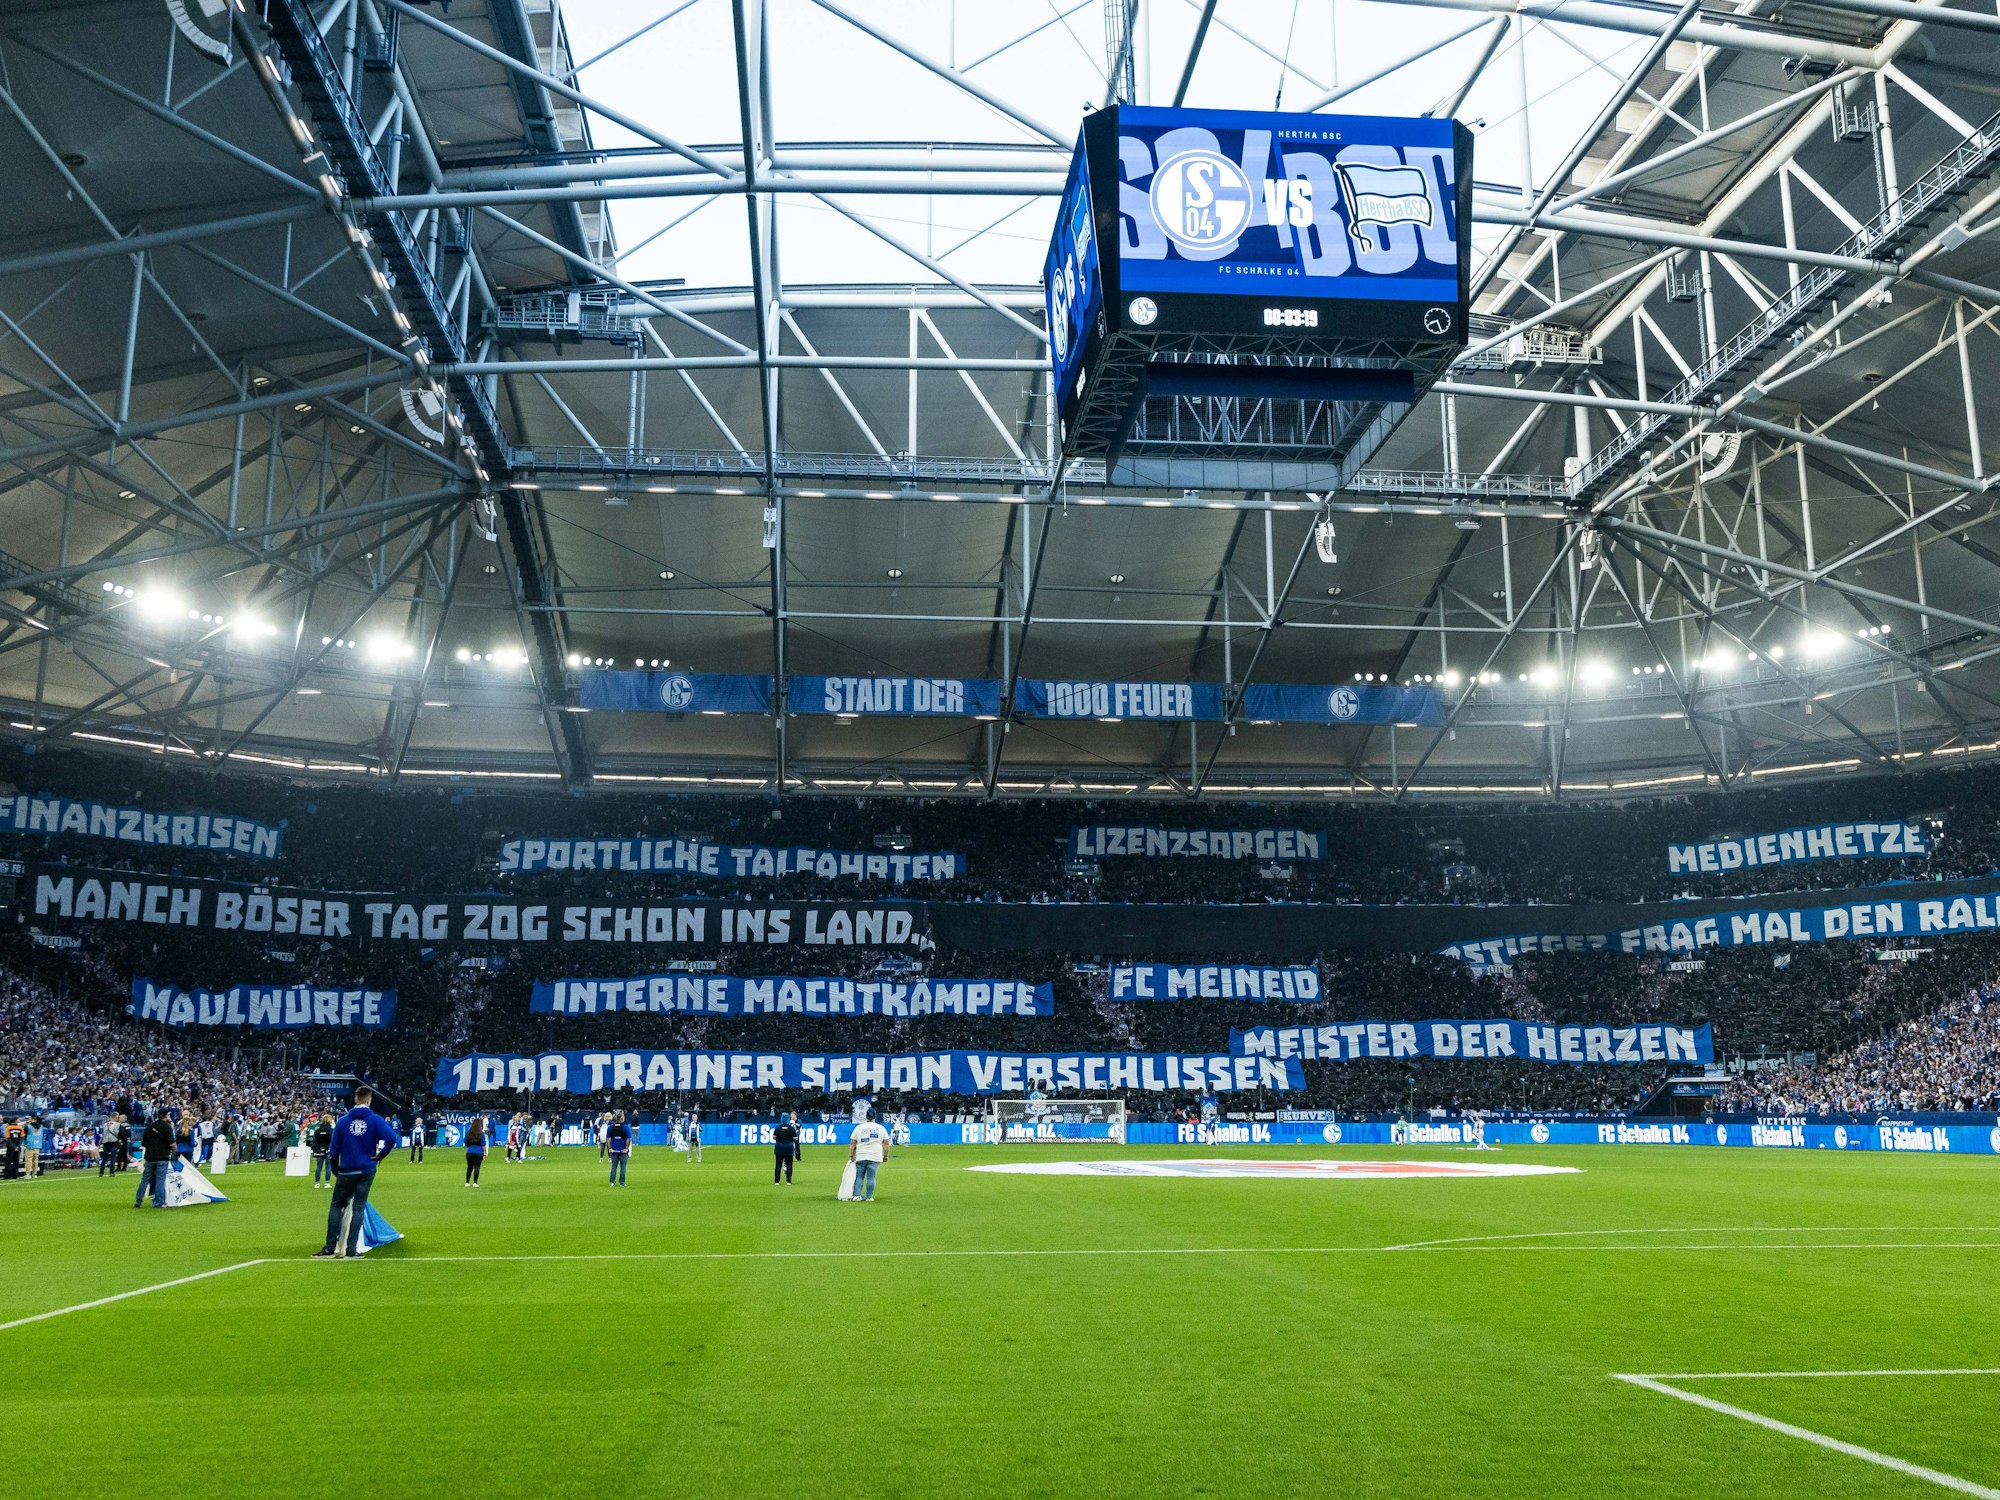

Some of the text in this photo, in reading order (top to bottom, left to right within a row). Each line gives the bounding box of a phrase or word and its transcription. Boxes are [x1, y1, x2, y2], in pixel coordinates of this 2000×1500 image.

[1278, 130, 1342, 141] HERTHA BSC
[1263, 178, 1314, 228] VS
[1218, 265, 1232, 274] FC
[1287, 268, 1300, 276] 04
[1263, 308, 1319, 327] 00:03:19
[825, 677, 964, 713] STADT DER
[1045, 682, 1193, 718] 1000 FEUER
[500, 839, 720, 876] SPORTLICHE
[1076, 827, 1320, 859] LIZENZSORGEN
[1668, 823, 1925, 873] MEDIENHETZE
[35, 874, 202, 927] MANCH
[215, 887, 352, 938] BÖSER
[365, 903, 449, 940] TAG
[463, 904, 548, 941] ZOG
[562, 906, 706, 942] SCHON
[721, 908, 791, 944] INS
[1620, 918, 1720, 953] FRAG
[1731, 912, 1811, 945] MAL
[1824, 902, 1904, 939] DEN
[1919, 895, 2000, 931] RAL
[683, 961, 712, 970] VELTINS
[553, 977, 1036, 1017] INTERNE MACHTKÄMPFE
[1113, 967, 1320, 999] FC MEINEID
[142, 983, 383, 1026] MAULWÜRFE
[1243, 1023, 1698, 1062] MEISTER DER HERZEN
[453, 1053, 1290, 1094] 1000 TRAINER SCHON VERSCHLISSEN
[1283, 1111, 1326, 1121] KURVE
[741, 1124, 759, 1144] FC
[817, 1124, 837, 1144] 04
[961, 1124, 979, 1143] FC
[1177, 1124, 1194, 1144] FC
[1252, 1124, 1272, 1144] 04
[1410, 1123, 1461, 1144] Schalke
[1597, 1125, 1691, 1145] FC Schalke 04
[1762, 1126, 1793, 1147] Schalke
[1793, 1126, 1806, 1148] 04
[1879, 1127, 1950, 1152] FC Schalke 04
